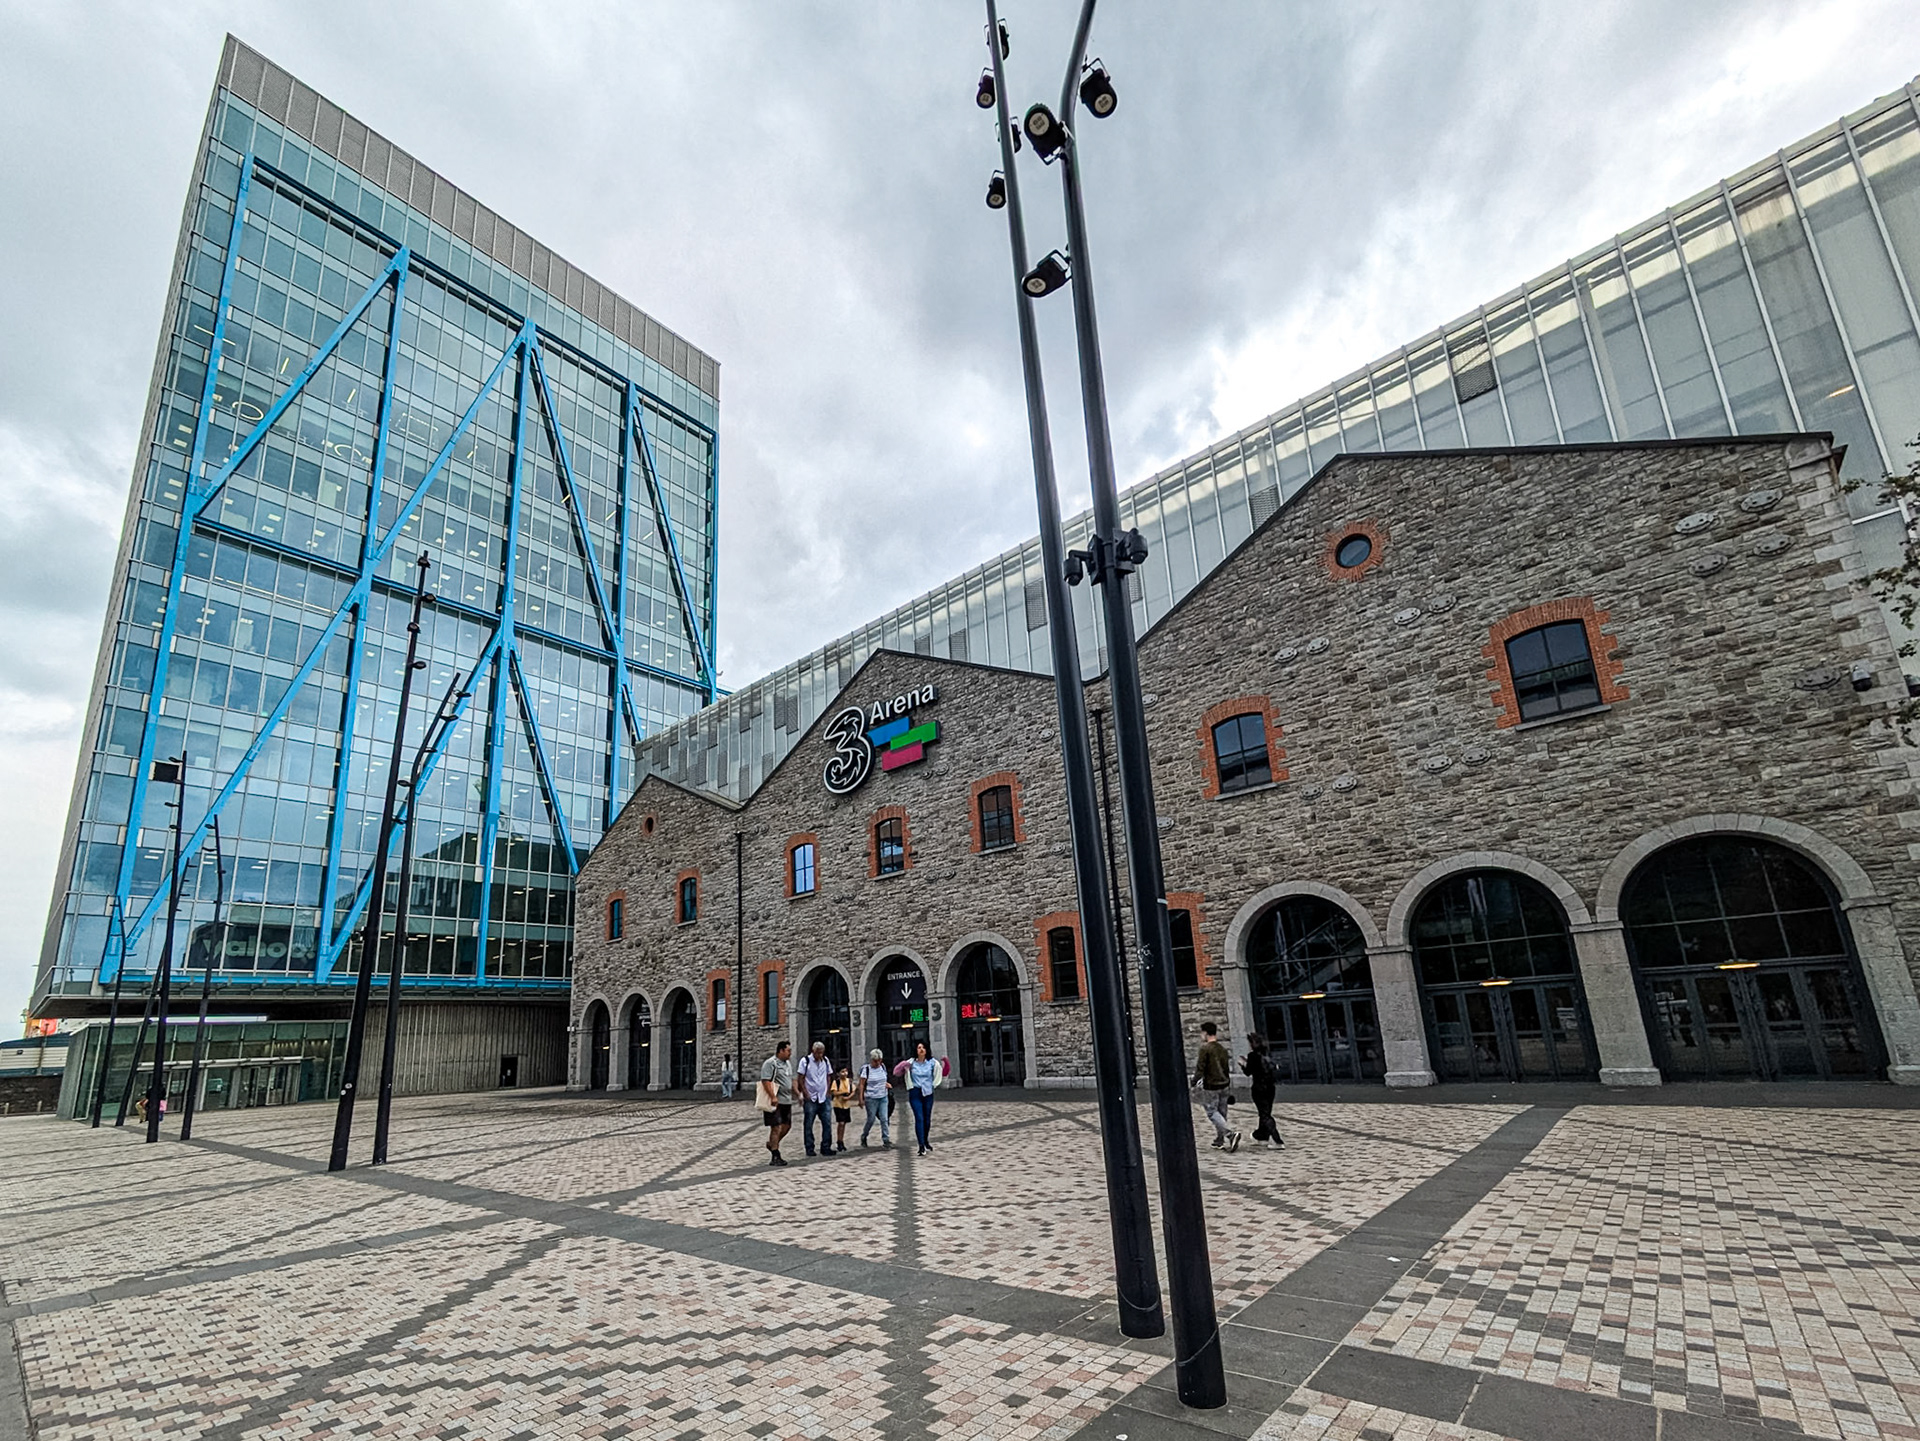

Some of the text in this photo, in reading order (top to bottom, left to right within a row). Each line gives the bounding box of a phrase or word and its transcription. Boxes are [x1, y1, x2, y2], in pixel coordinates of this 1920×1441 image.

[823, 684, 934, 793] 3 Arena
[887, 970, 920, 981] ENTRANCE
[852, 1009, 861, 1027] 3
[931, 1002, 942, 1021] 3
